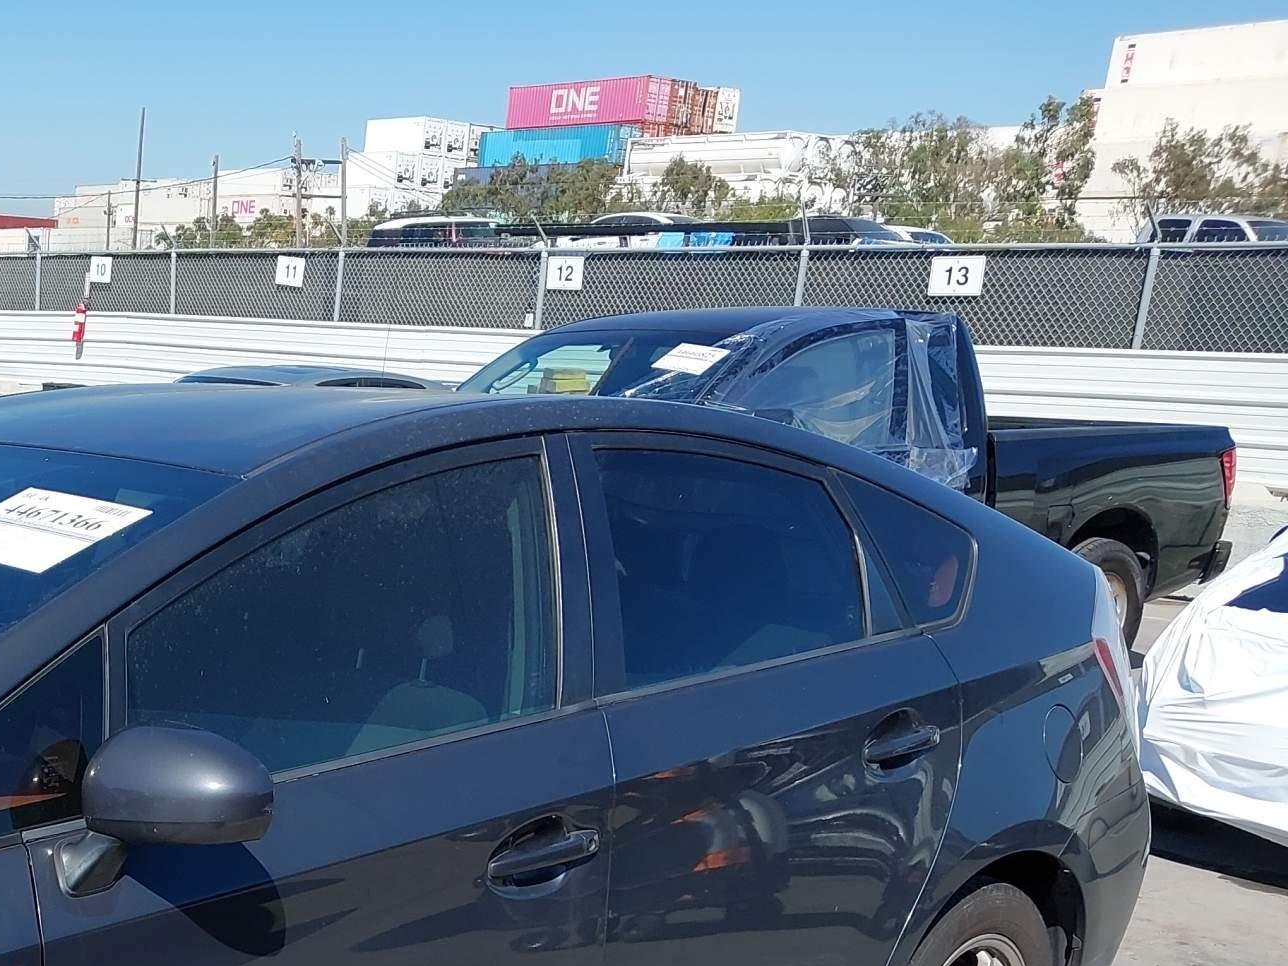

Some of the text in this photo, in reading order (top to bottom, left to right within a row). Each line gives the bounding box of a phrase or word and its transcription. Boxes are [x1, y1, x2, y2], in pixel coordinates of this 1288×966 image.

[549, 86, 601, 115] ONE
[231, 200, 256, 215] ONE
[95, 263, 107, 277] 10
[285, 264, 297, 280] 11
[556, 264, 574, 282] 12
[944, 265, 970, 286] 13
[4, 503, 107, 531] 44671366
